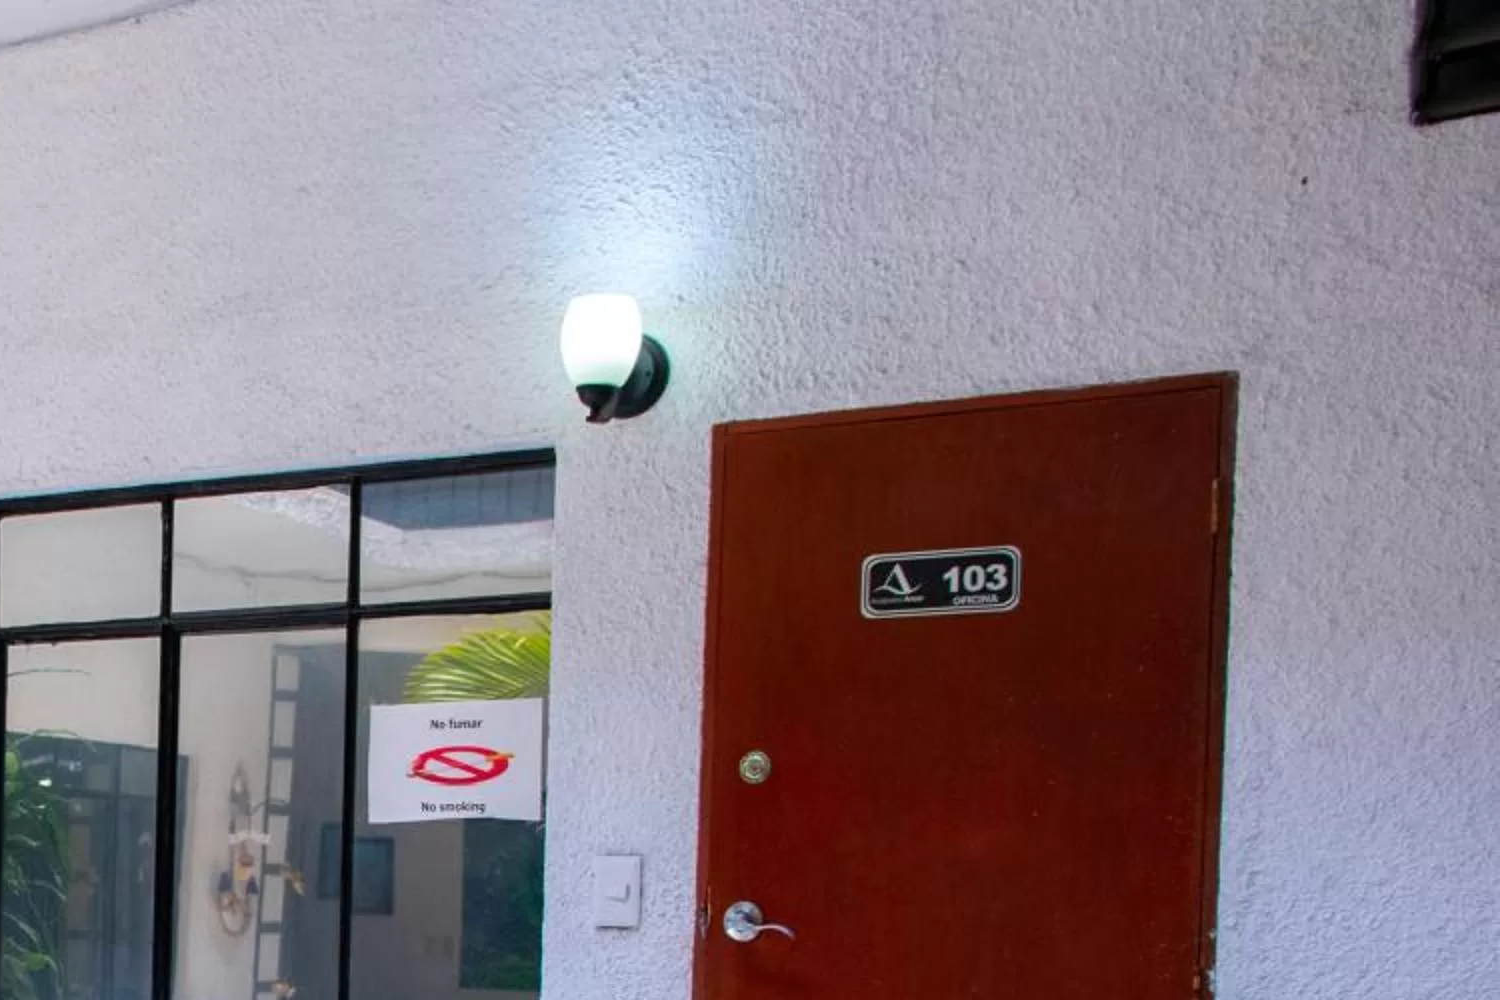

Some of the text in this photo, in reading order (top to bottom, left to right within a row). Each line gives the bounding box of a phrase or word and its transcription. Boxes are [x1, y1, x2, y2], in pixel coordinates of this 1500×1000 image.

[942, 563, 1008, 593] 103
[430, 718, 483, 730] No fumar
[421, 801, 487, 814] No smoking
